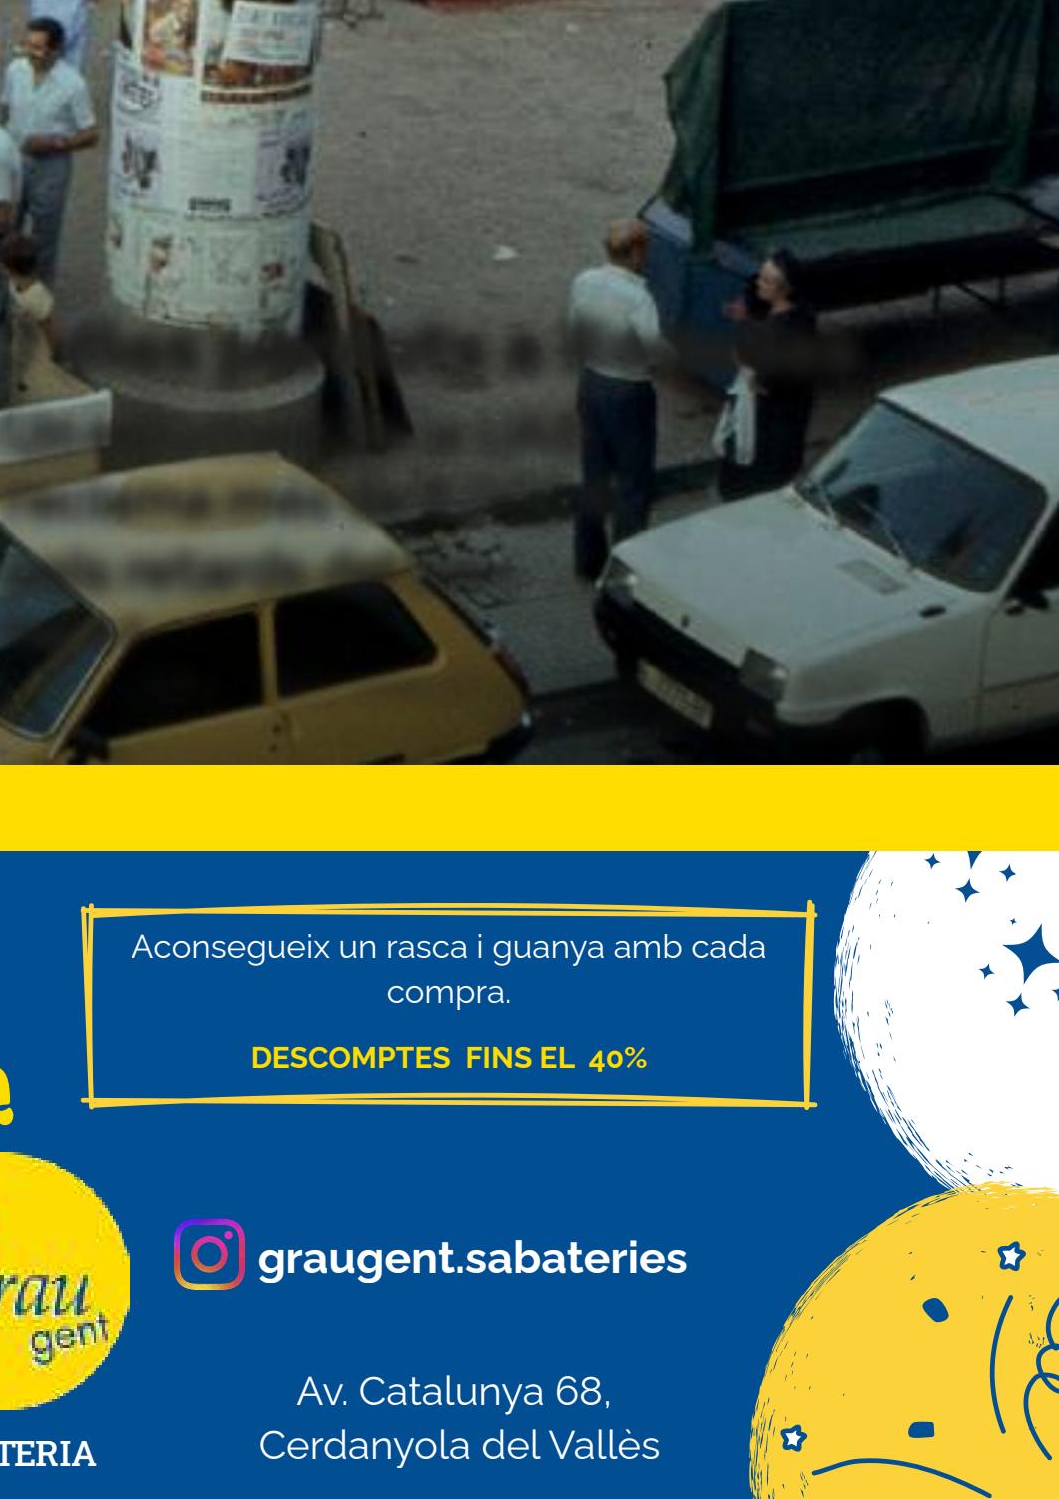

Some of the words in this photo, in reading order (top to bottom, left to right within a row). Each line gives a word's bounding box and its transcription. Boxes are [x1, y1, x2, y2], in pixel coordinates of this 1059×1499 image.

[131, 933, 330, 967] Aconsegueix
[339, 940, 376, 959] un
[386, 940, 468, 959] rasca
[477, 932, 483, 959] i
[492, 940, 605, 967] guanya
[614, 933, 683, 959] amb
[691, 933, 766, 959] cada
[386, 984, 511, 1012] compra.
[252, 1046, 451, 1069] DESCOMPTES
[466, 1046, 533, 1069] FINS
[540, 1046, 577, 1069] EL
[588, 1046, 648, 1073] 40%
[258, 1239, 687, 1284] graugent.sabateries
[30, 1312, 110, 1366] gent
[296, 1376, 348, 1406] Av.
[359, 1374, 544, 1416] Catalunya
[556, 1375, 611, 1410] 68,
[259, 1428, 470, 1469] Cerdanyola
[482, 1428, 541, 1460] del
[548, 1428, 660, 1460] Vallès
